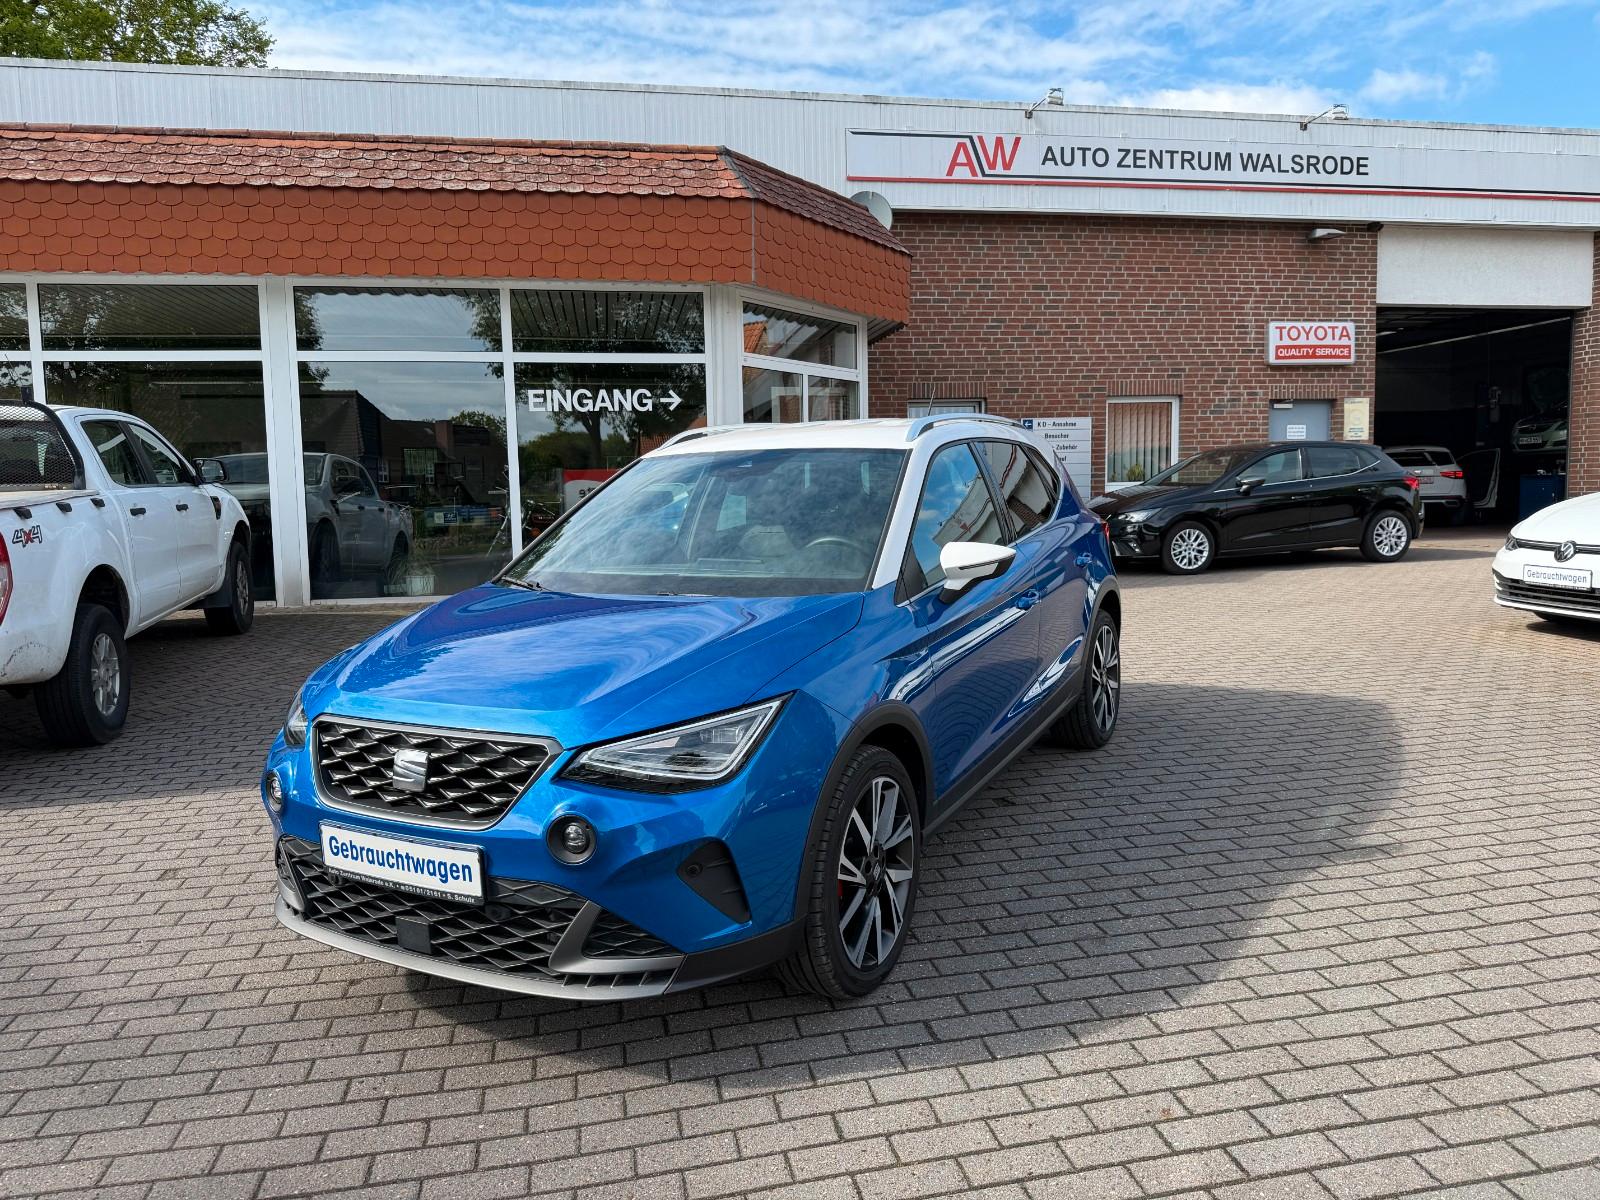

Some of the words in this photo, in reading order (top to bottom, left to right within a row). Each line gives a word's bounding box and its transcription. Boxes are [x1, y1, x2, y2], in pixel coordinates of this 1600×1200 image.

[1041, 146, 1110, 168] AUTO
[1116, 148, 1232, 172] ZENTRUM
[1239, 152, 1370, 176] WALSRODE
[1275, 325, 1352, 341] TOYOTA
[1277, 347, 1314, 357] QUALITY
[1316, 347, 1350, 356] SERVICE
[527, 388, 653, 413] EINGANG
[1526, 569, 1587, 584] Gebrauchtwagen
[329, 835, 473, 884] Gebrauchtwagen
